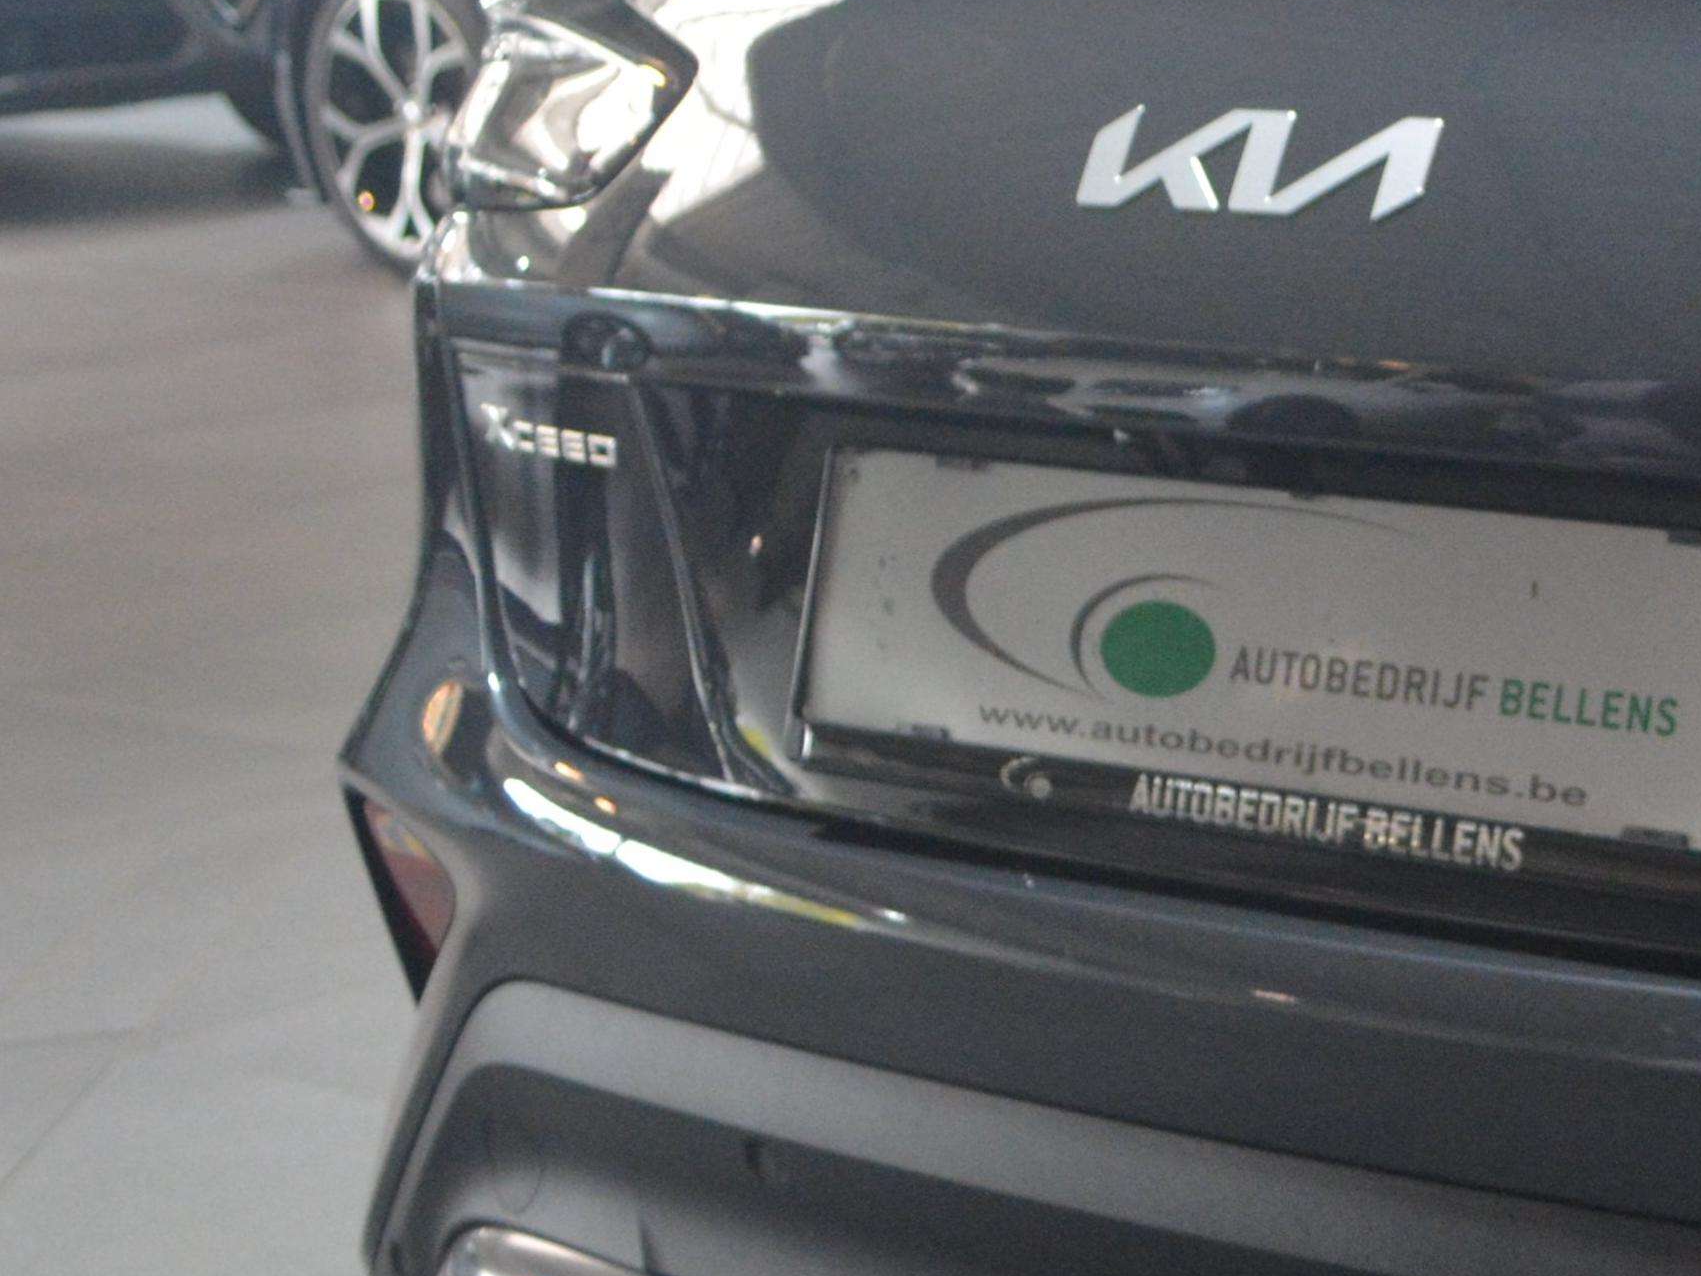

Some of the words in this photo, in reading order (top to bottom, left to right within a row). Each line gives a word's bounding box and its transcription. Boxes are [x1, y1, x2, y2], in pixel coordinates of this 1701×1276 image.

[1075, 103, 1445, 222] KIA
[1229, 645, 1491, 712] AUTOBEDRIJF
[1500, 677, 1679, 737] BELLENS
[977, 700, 1589, 808] www.autobedrijfbellens.be
[1128, 771, 1362, 840] AUTOBEDRIJF
[1363, 807, 1526, 872] BELLENS
